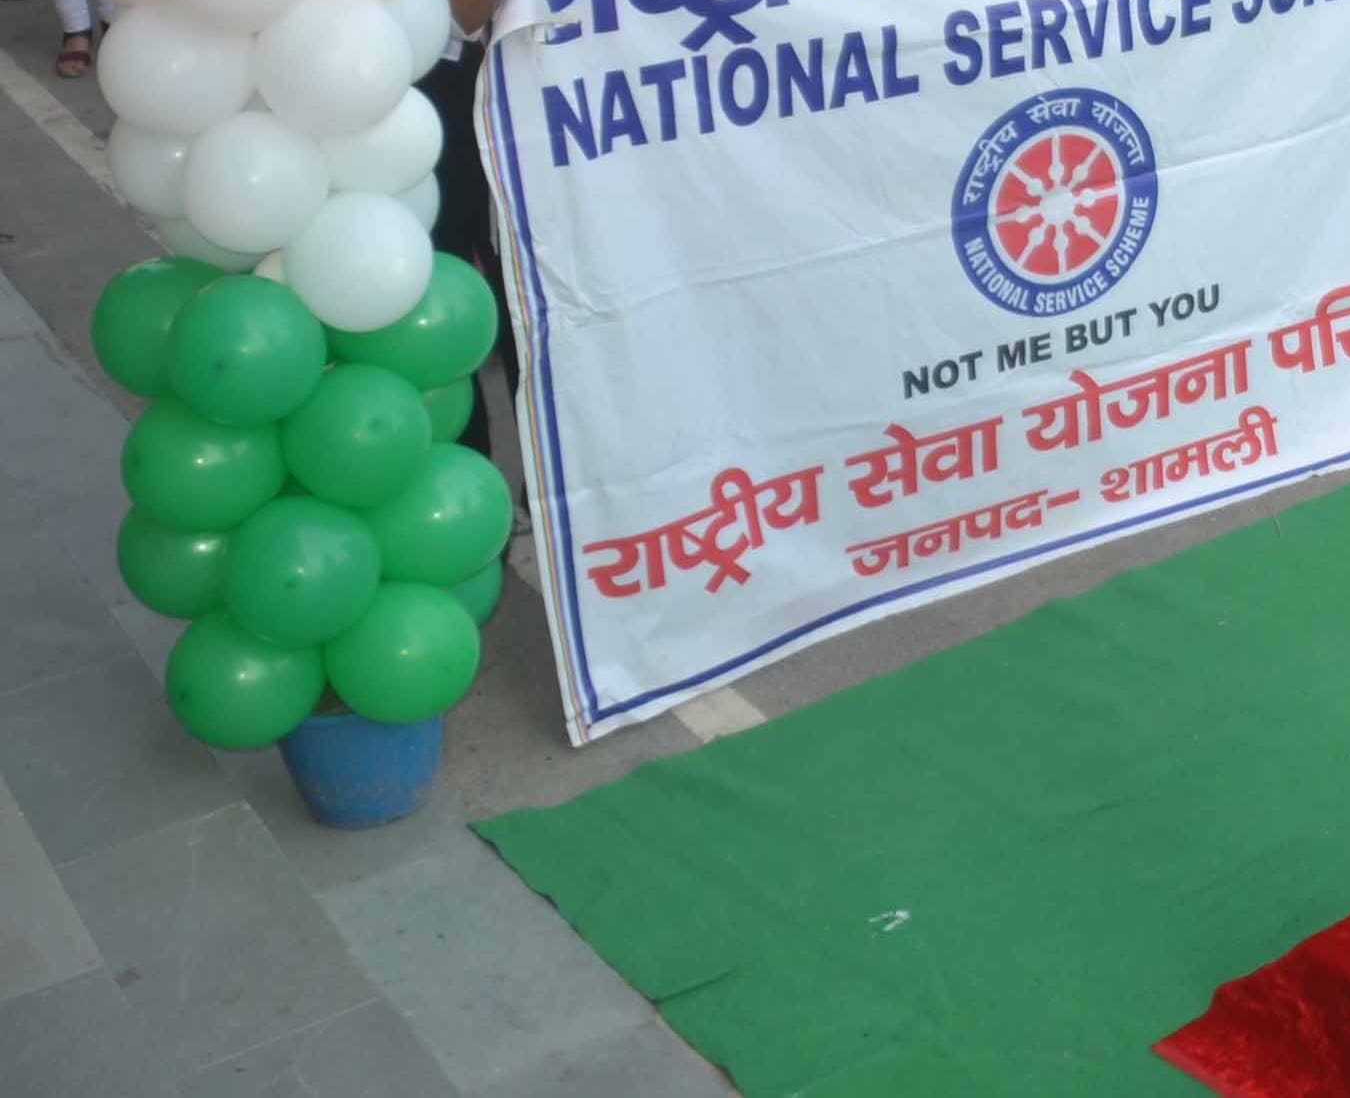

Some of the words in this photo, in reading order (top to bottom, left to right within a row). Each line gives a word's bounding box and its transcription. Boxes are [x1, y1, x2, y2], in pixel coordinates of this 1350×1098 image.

[541, 24, 921, 167] NATIONAL
[962, 120, 1019, 206] राष्ट्रीय
[1025, 96, 1081, 124] सेवा
[1090, 101, 1146, 167] योजना
[964, 236, 1030, 311] NATIONAL
[1034, 271, 1109, 314] SERVICE
[1105, 195, 1150, 278] SCHEME
[902, 351, 983, 399] NOT
[996, 333, 1051, 371] ME
[1065, 308, 1137, 354] BUT
[1149, 284, 1221, 326] YOU
[582, 467, 825, 599] राष्ट्रीय
[845, 414, 1004, 509] सेवा
[1021, 339, 1252, 452] योजना
[1100, 405, 1279, 503] शामली
